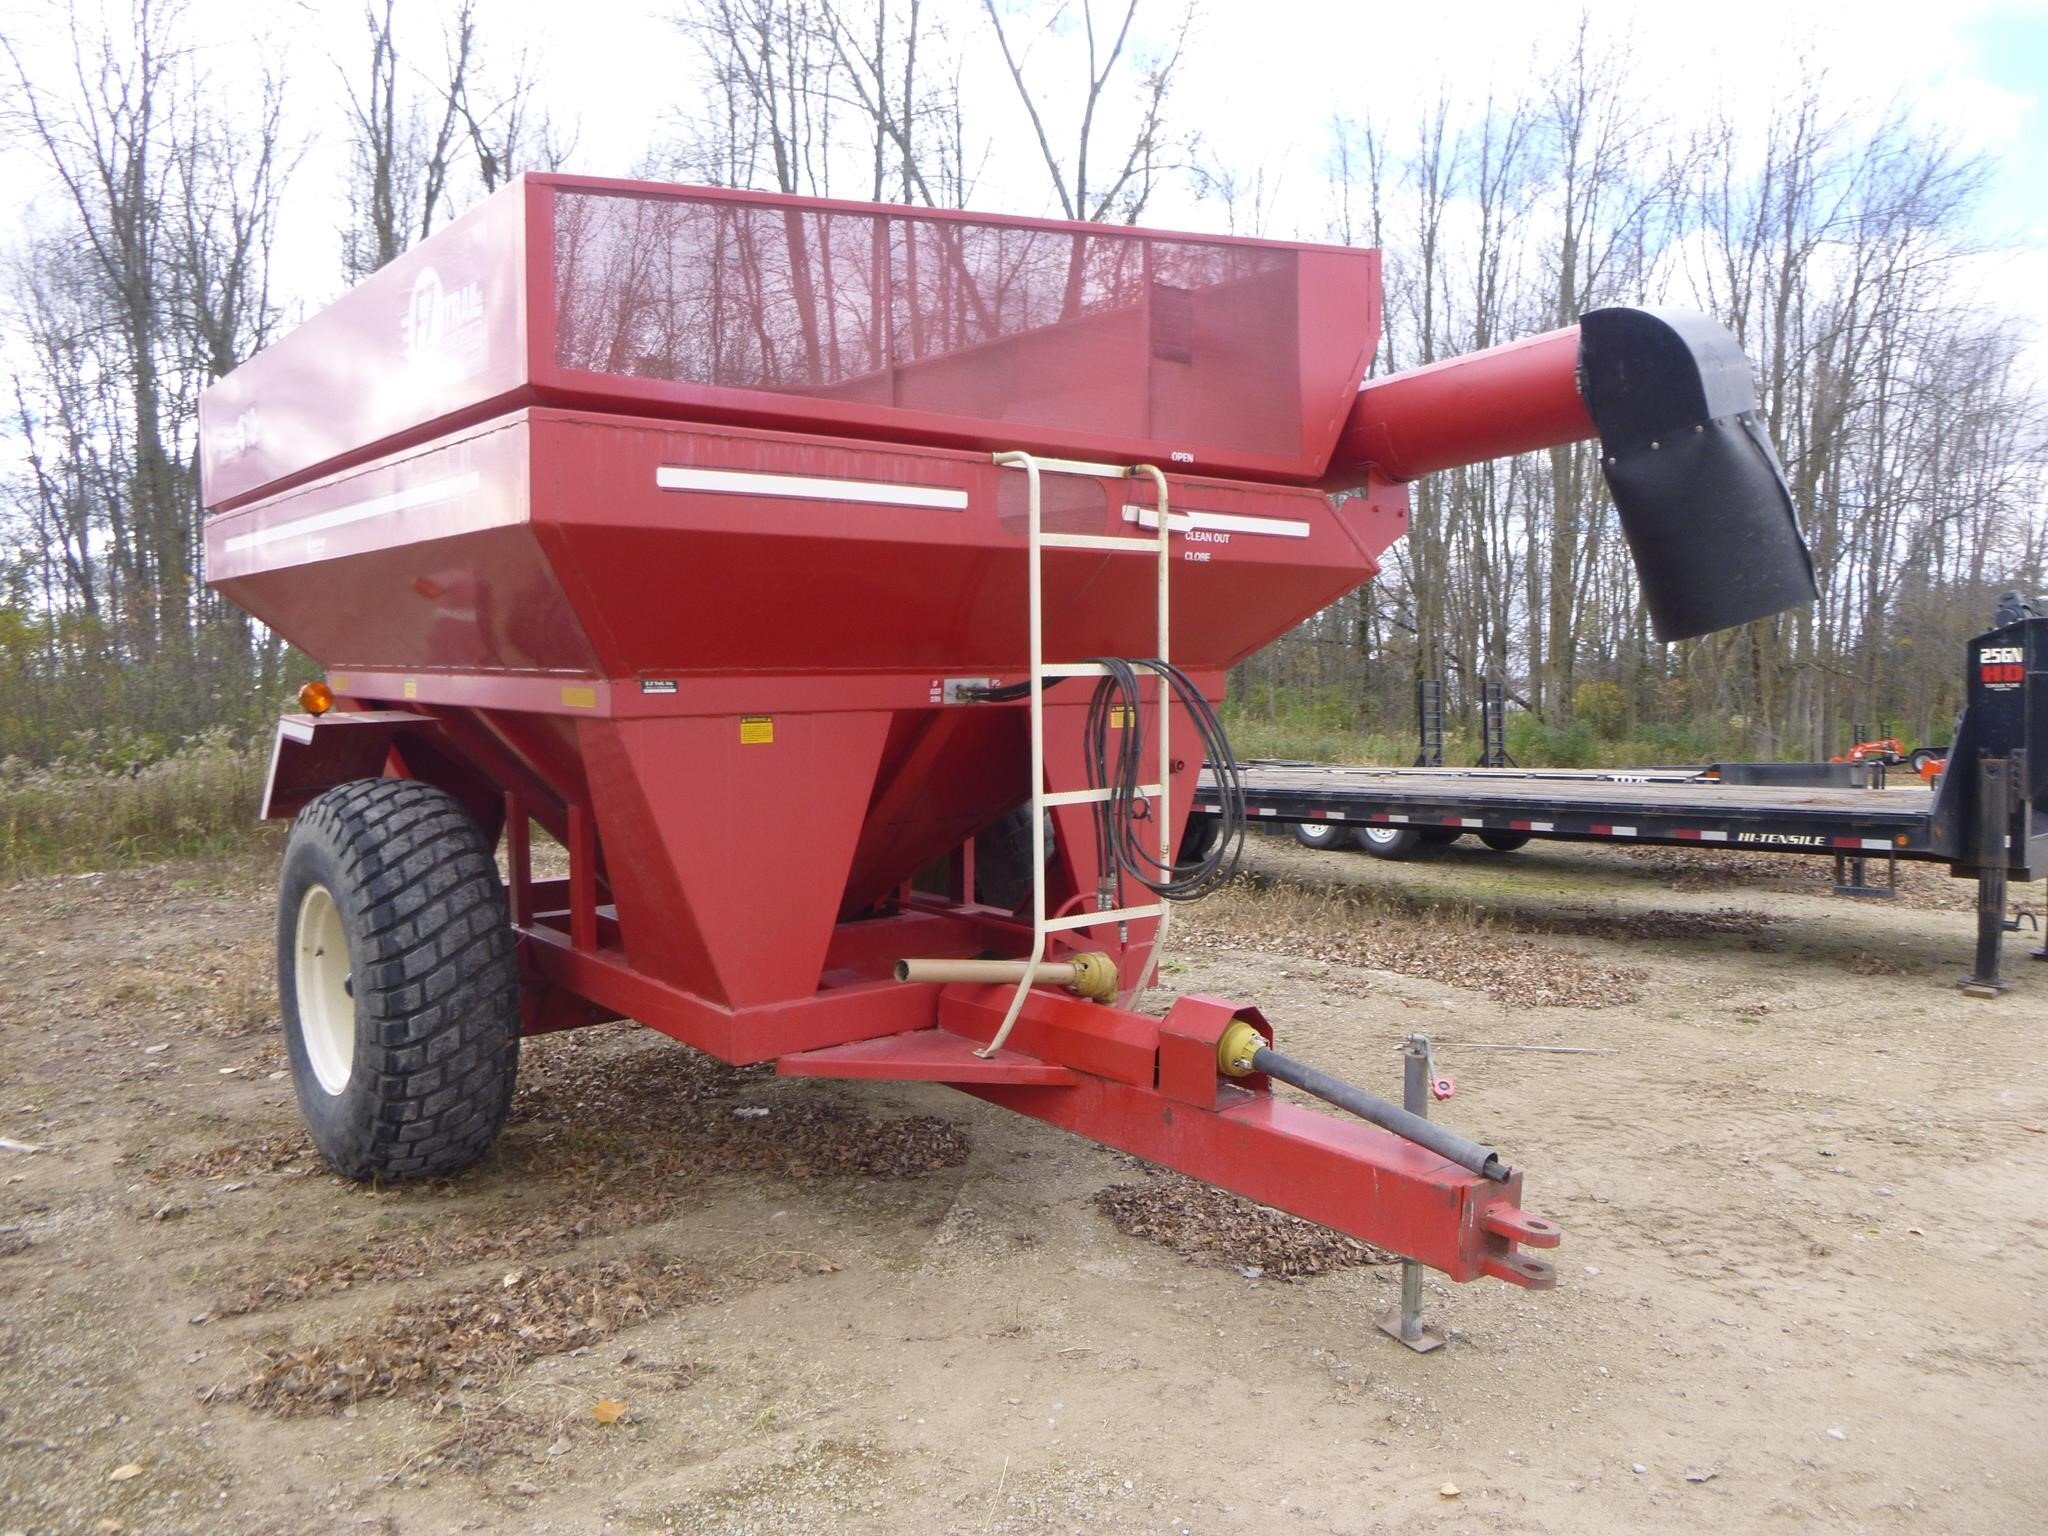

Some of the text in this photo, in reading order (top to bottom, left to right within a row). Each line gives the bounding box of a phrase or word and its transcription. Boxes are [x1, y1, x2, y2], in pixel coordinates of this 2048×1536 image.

[1171, 451, 1194, 463] OPEN
[1184, 531, 1231, 544] CLEAN OUT
[1184, 551, 1211, 562] CLOSE
[1982, 665, 2023, 683] HD
[1737, 832, 1826, 846] HI-TENSILE
